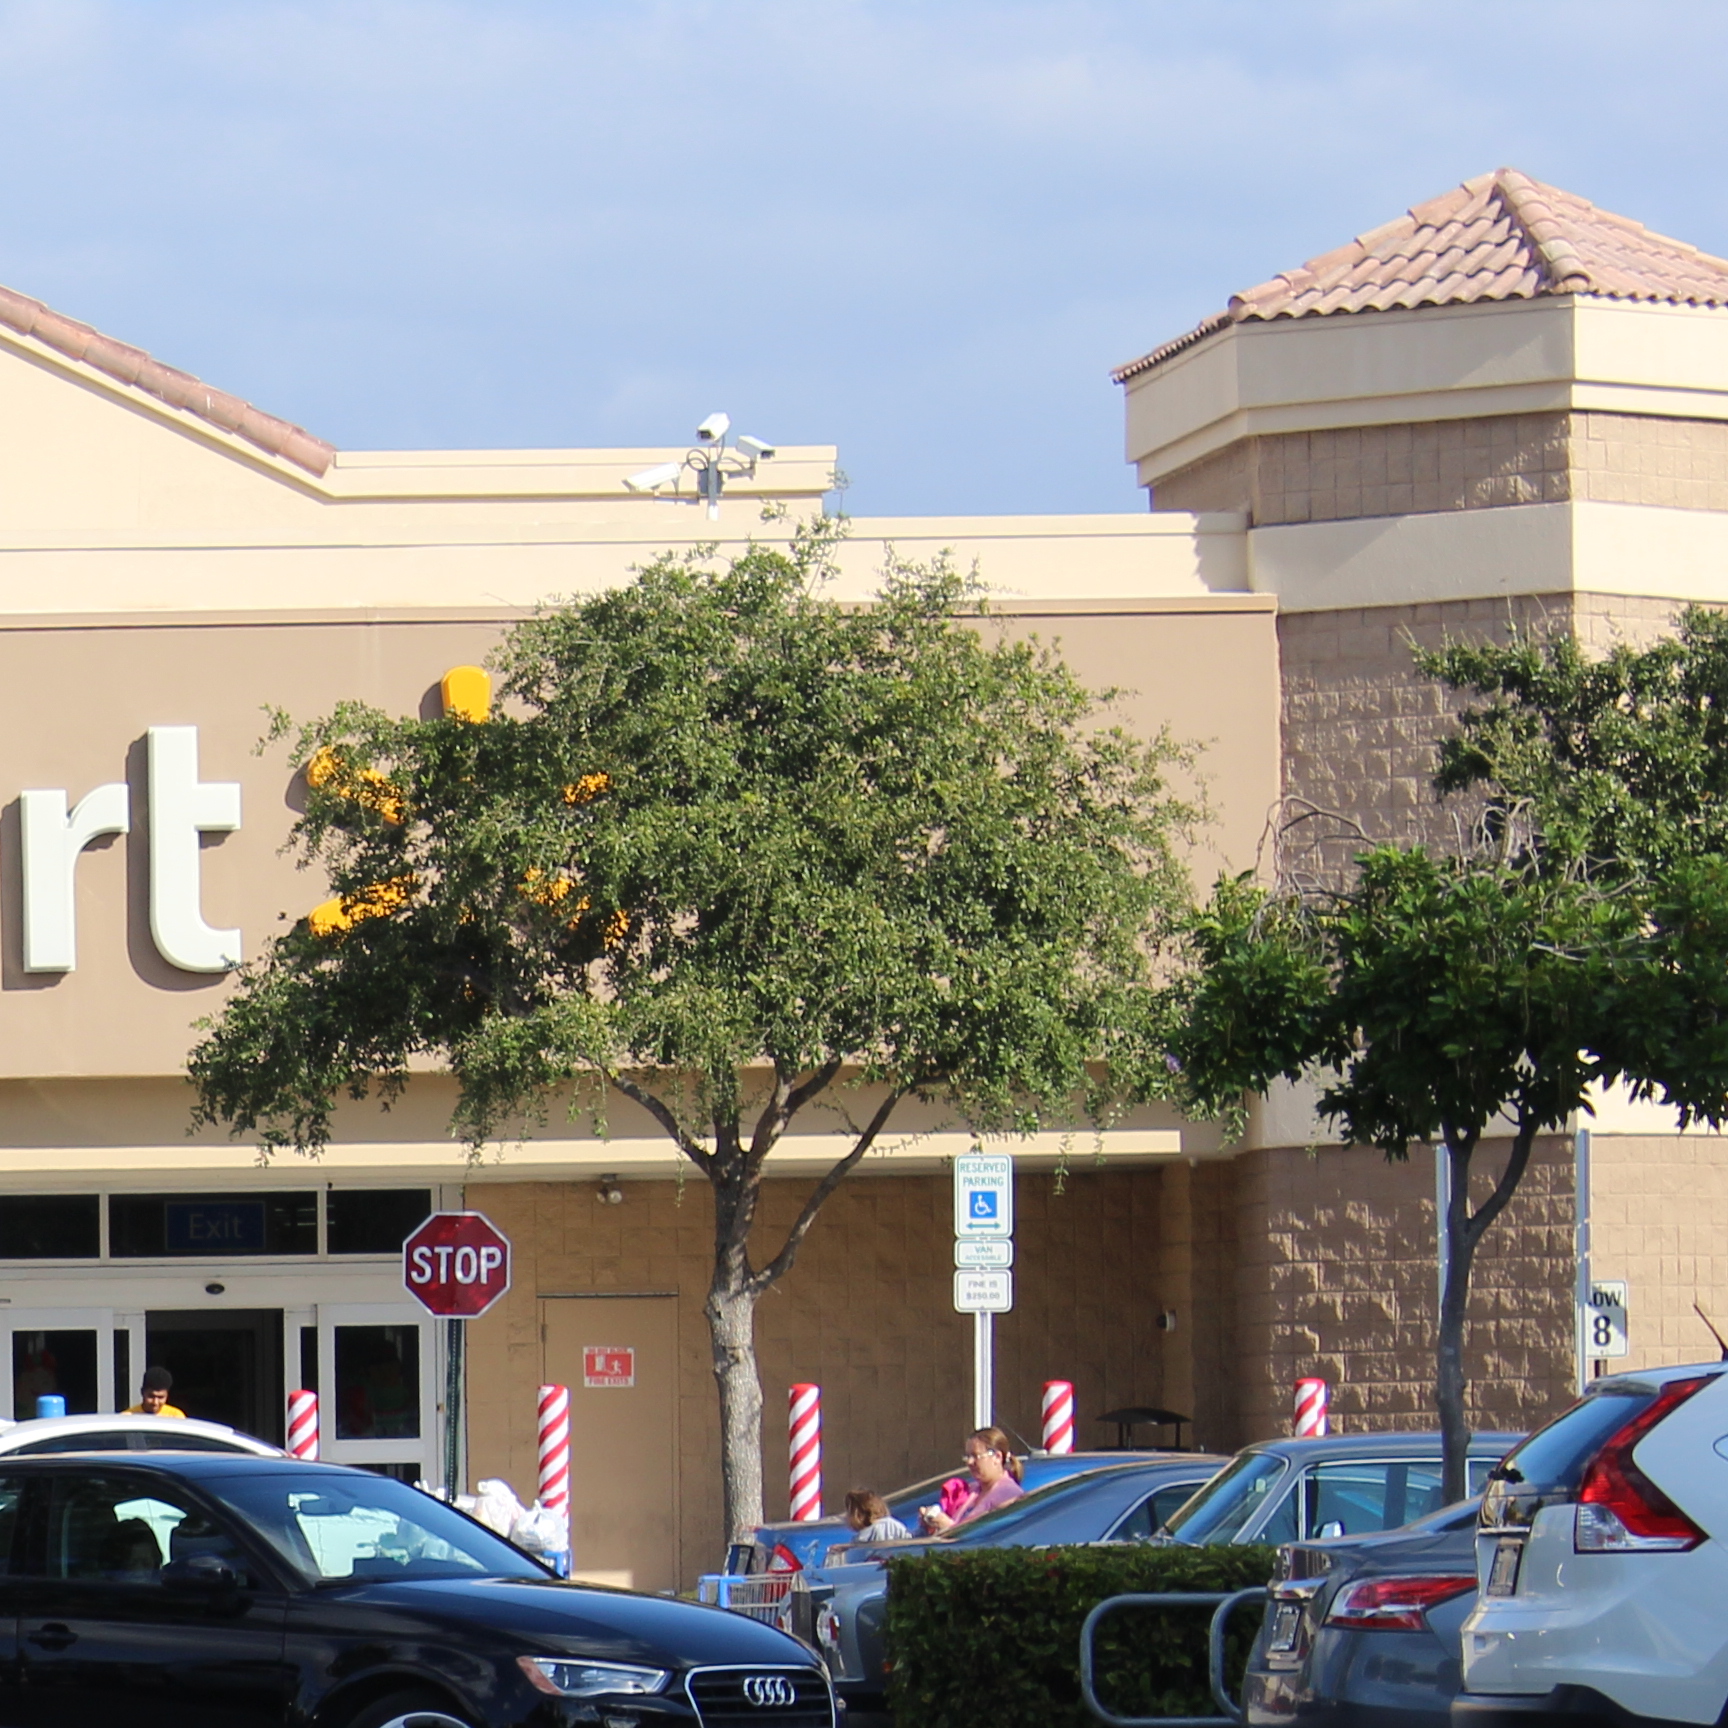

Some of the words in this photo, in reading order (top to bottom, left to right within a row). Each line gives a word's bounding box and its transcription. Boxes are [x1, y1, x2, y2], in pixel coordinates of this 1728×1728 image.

[960, 1162, 1007, 1174] RESERVED
[963, 1176, 1004, 1187] PARKING
[189, 1213, 243, 1239] Exit
[974, 1245, 993, 1254] VAN
[410, 1246, 502, 1284] STOP
[968, 1280, 986, 1288] FINE
[1588, 1290, 1622, 1307] OW
[1593, 1315, 1611, 1347] 8
